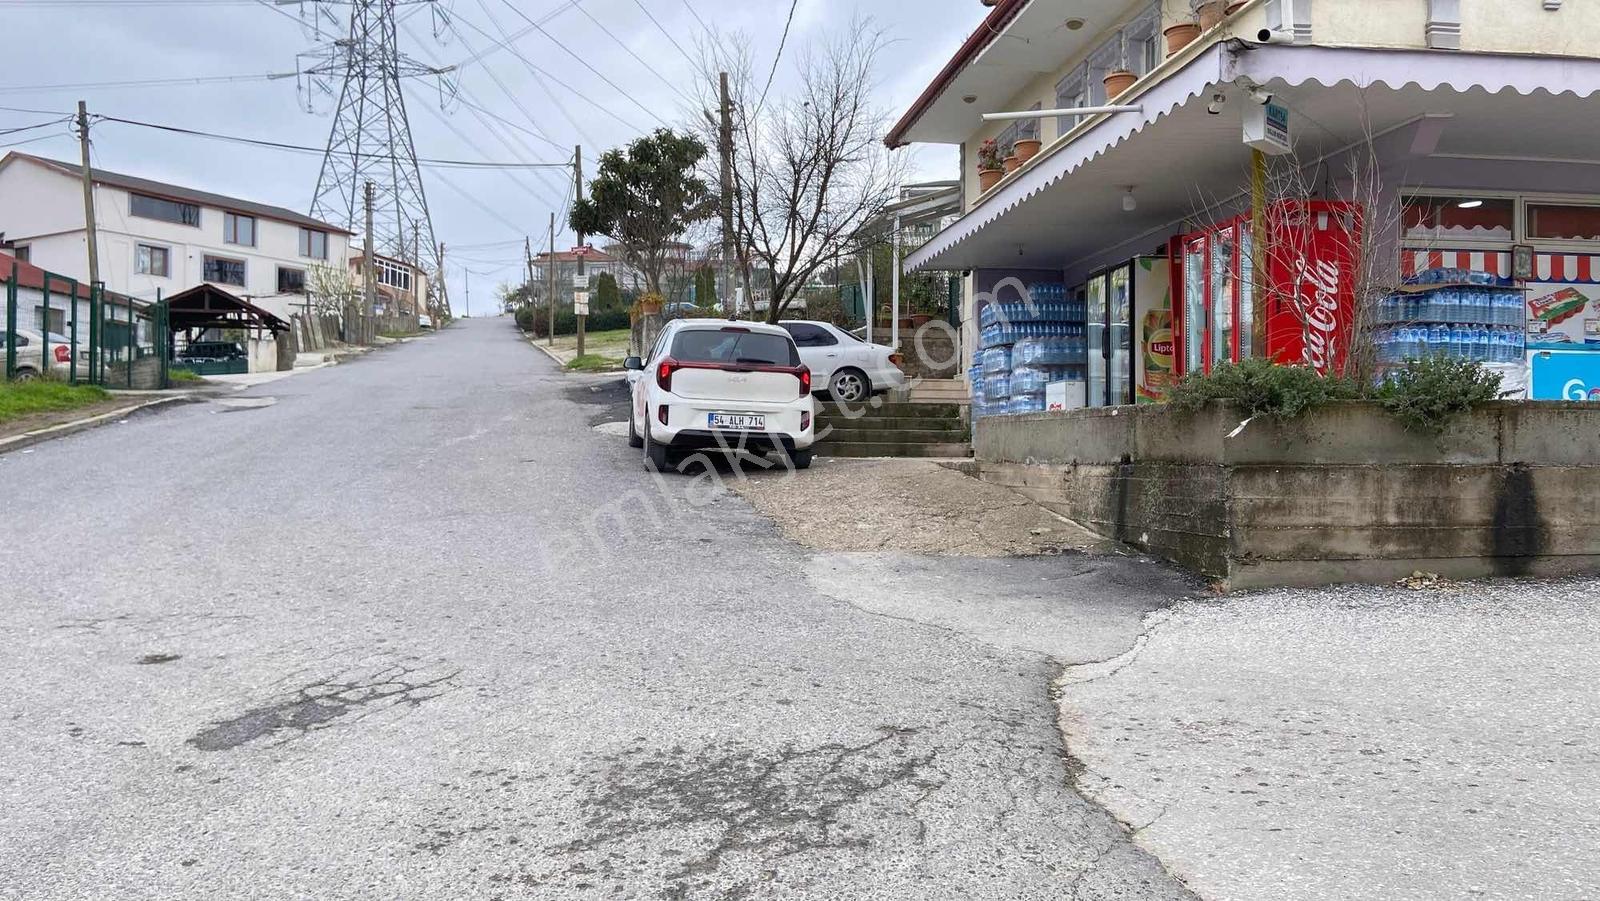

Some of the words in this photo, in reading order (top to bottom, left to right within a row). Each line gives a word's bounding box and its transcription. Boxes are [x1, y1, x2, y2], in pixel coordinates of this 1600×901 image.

[1153, 343, 1175, 354] Lipto
[714, 415, 724, 425] 54
[729, 415, 744, 426] ALH
[748, 416, 763, 426] 714
